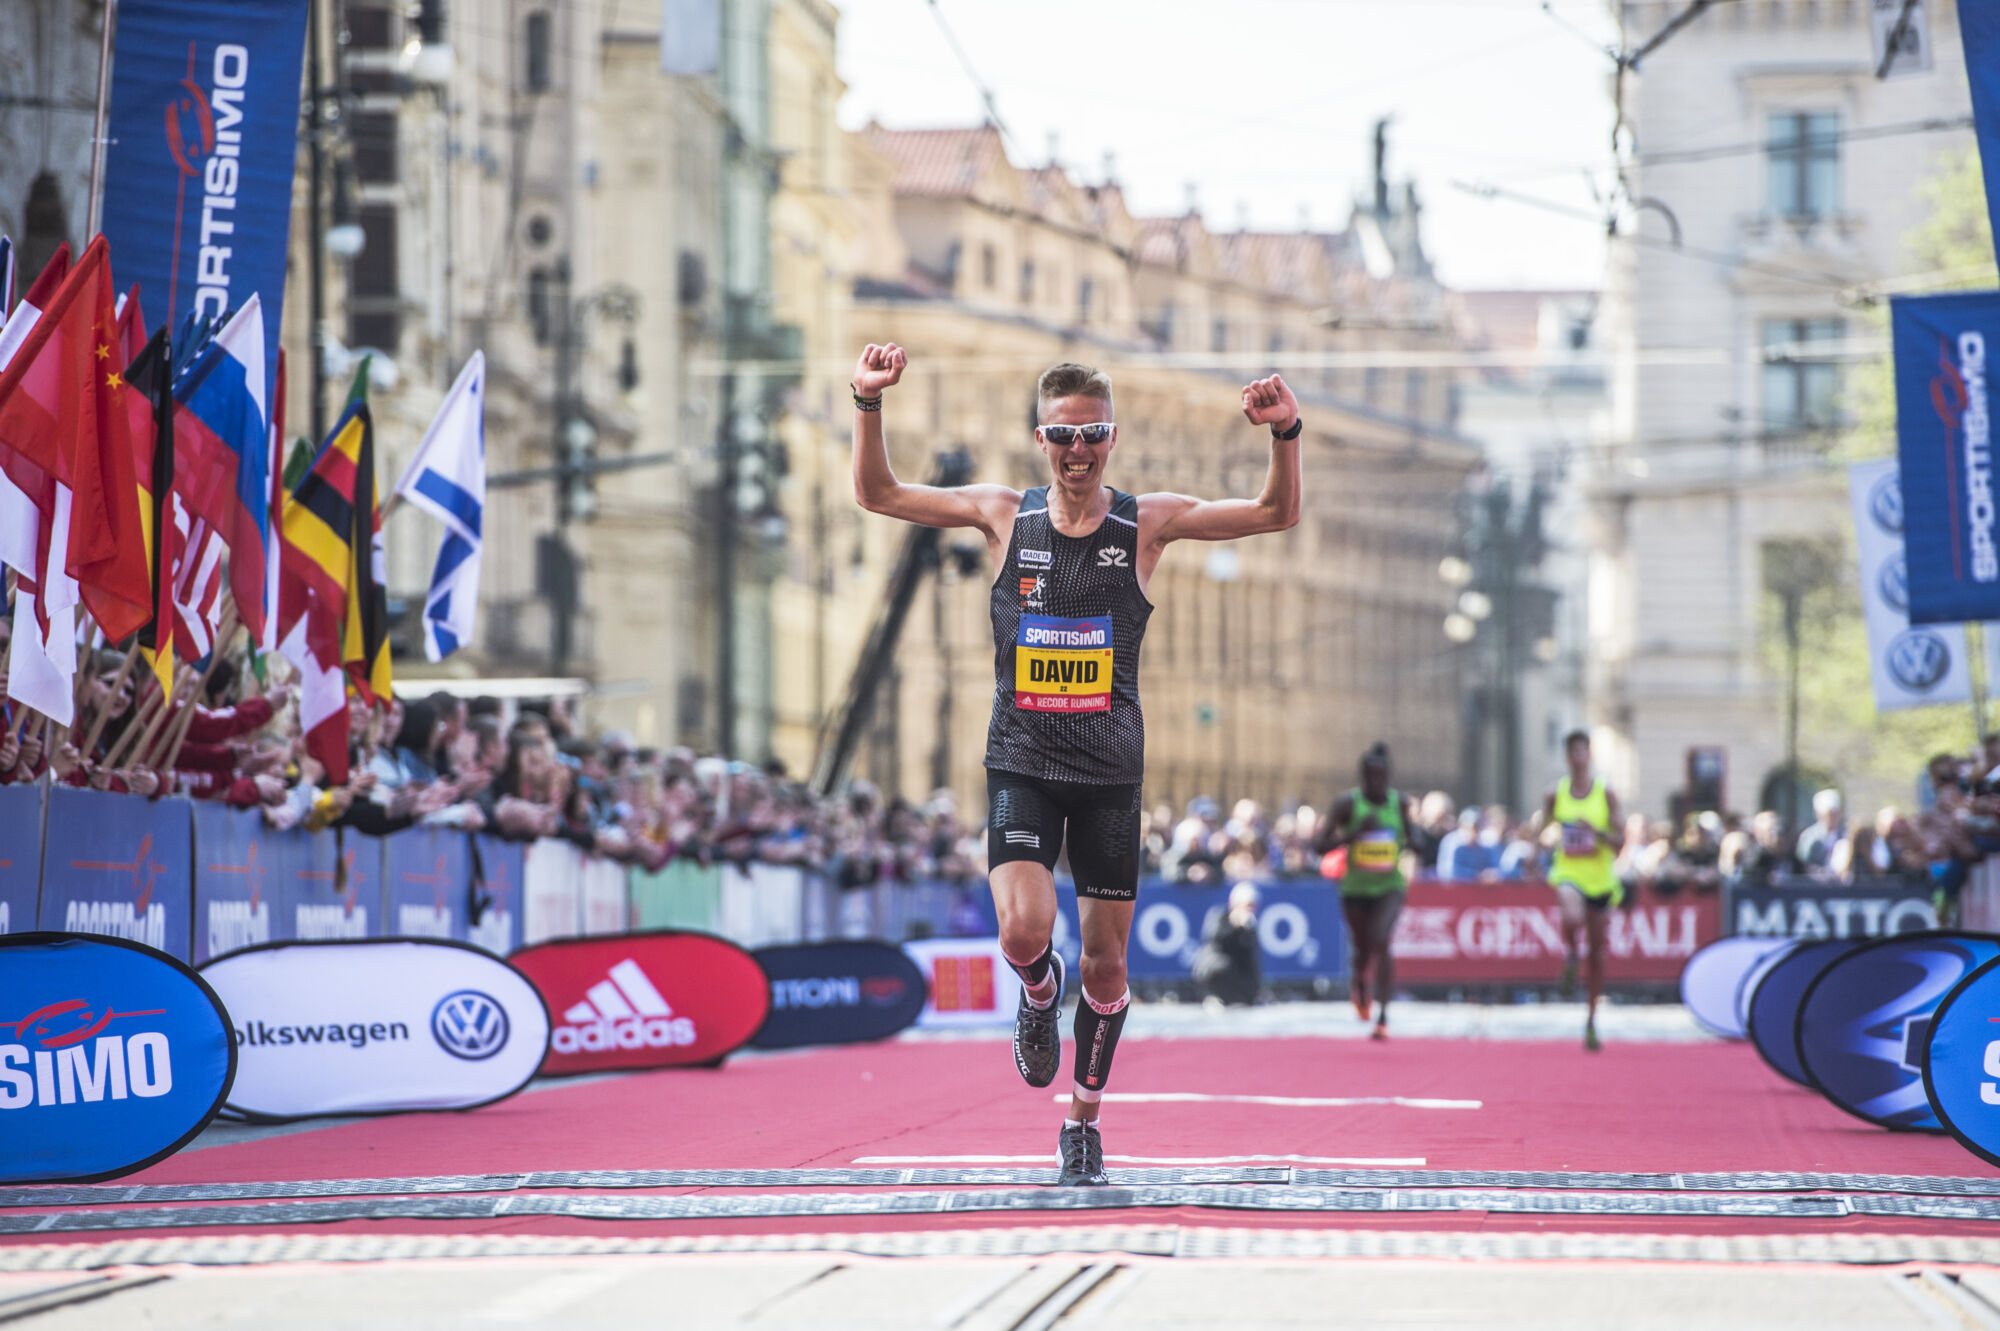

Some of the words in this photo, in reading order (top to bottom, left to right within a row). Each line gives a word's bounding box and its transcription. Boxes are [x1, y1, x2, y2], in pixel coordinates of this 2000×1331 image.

[1022, 551, 1049, 561] MADETA
[1025, 628, 1105, 646] SPORTISIMO
[1030, 658, 1099, 684] DAVID
[1037, 697, 1069, 708] RECODE
[1071, 696, 1106, 708] RUNNING
[552, 1015, 697, 1054] adidas
